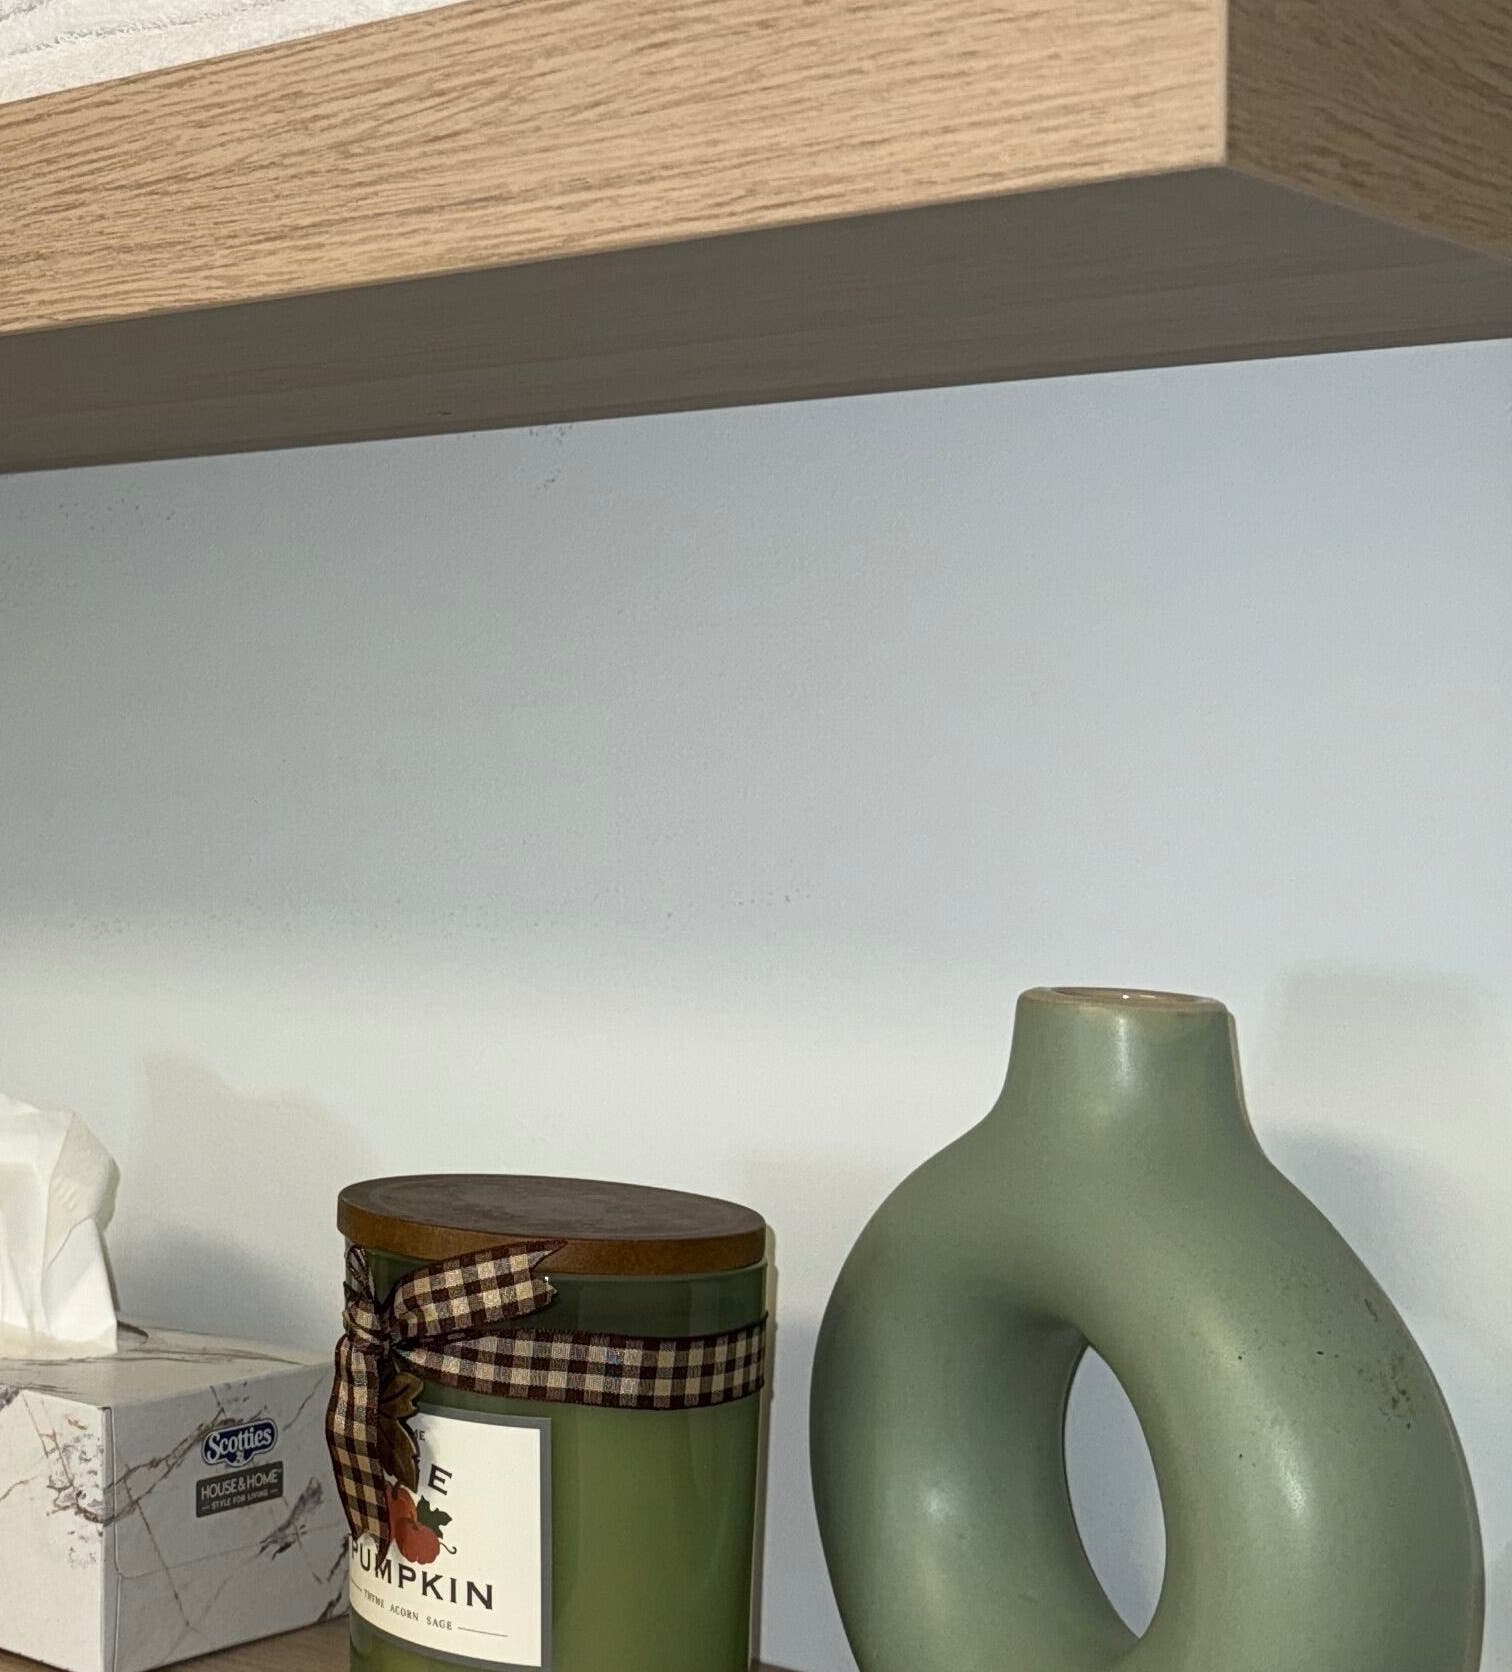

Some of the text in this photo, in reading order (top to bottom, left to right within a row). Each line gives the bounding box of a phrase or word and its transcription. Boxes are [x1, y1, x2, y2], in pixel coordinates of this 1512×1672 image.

[206, 1426, 272, 1463] Scotties
[390, 1603, 419, 1621] ACORN
[426, 1615, 453, 1631] SAGE
